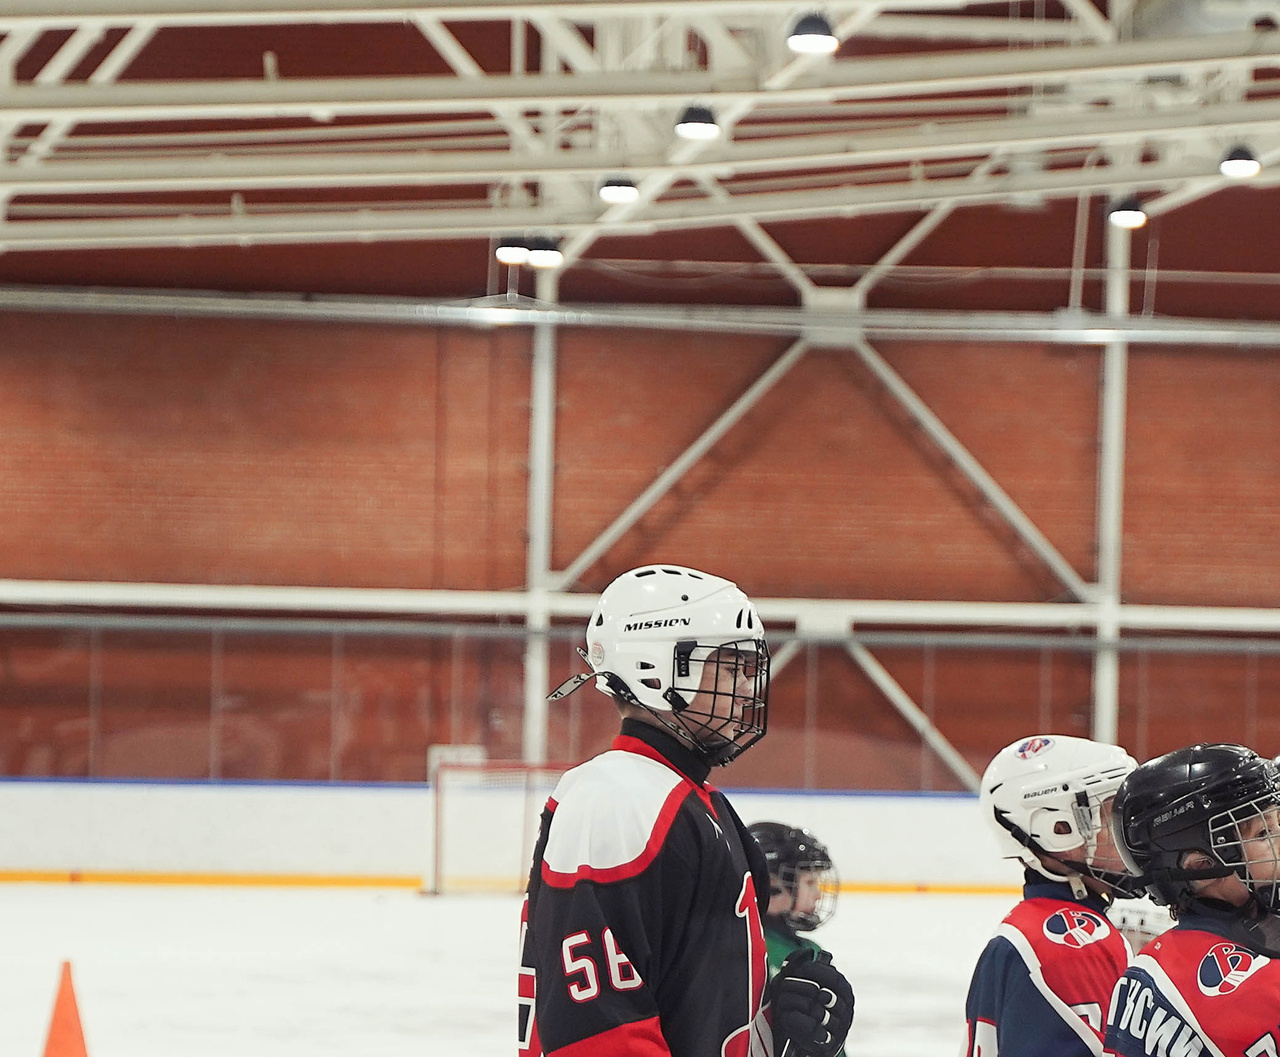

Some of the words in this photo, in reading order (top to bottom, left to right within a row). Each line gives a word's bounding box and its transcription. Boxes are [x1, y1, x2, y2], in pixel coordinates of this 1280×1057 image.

[624, 617, 691, 632] MISSION
[1023, 786, 1058, 799] BAUER
[562, 926, 645, 1004] 56
